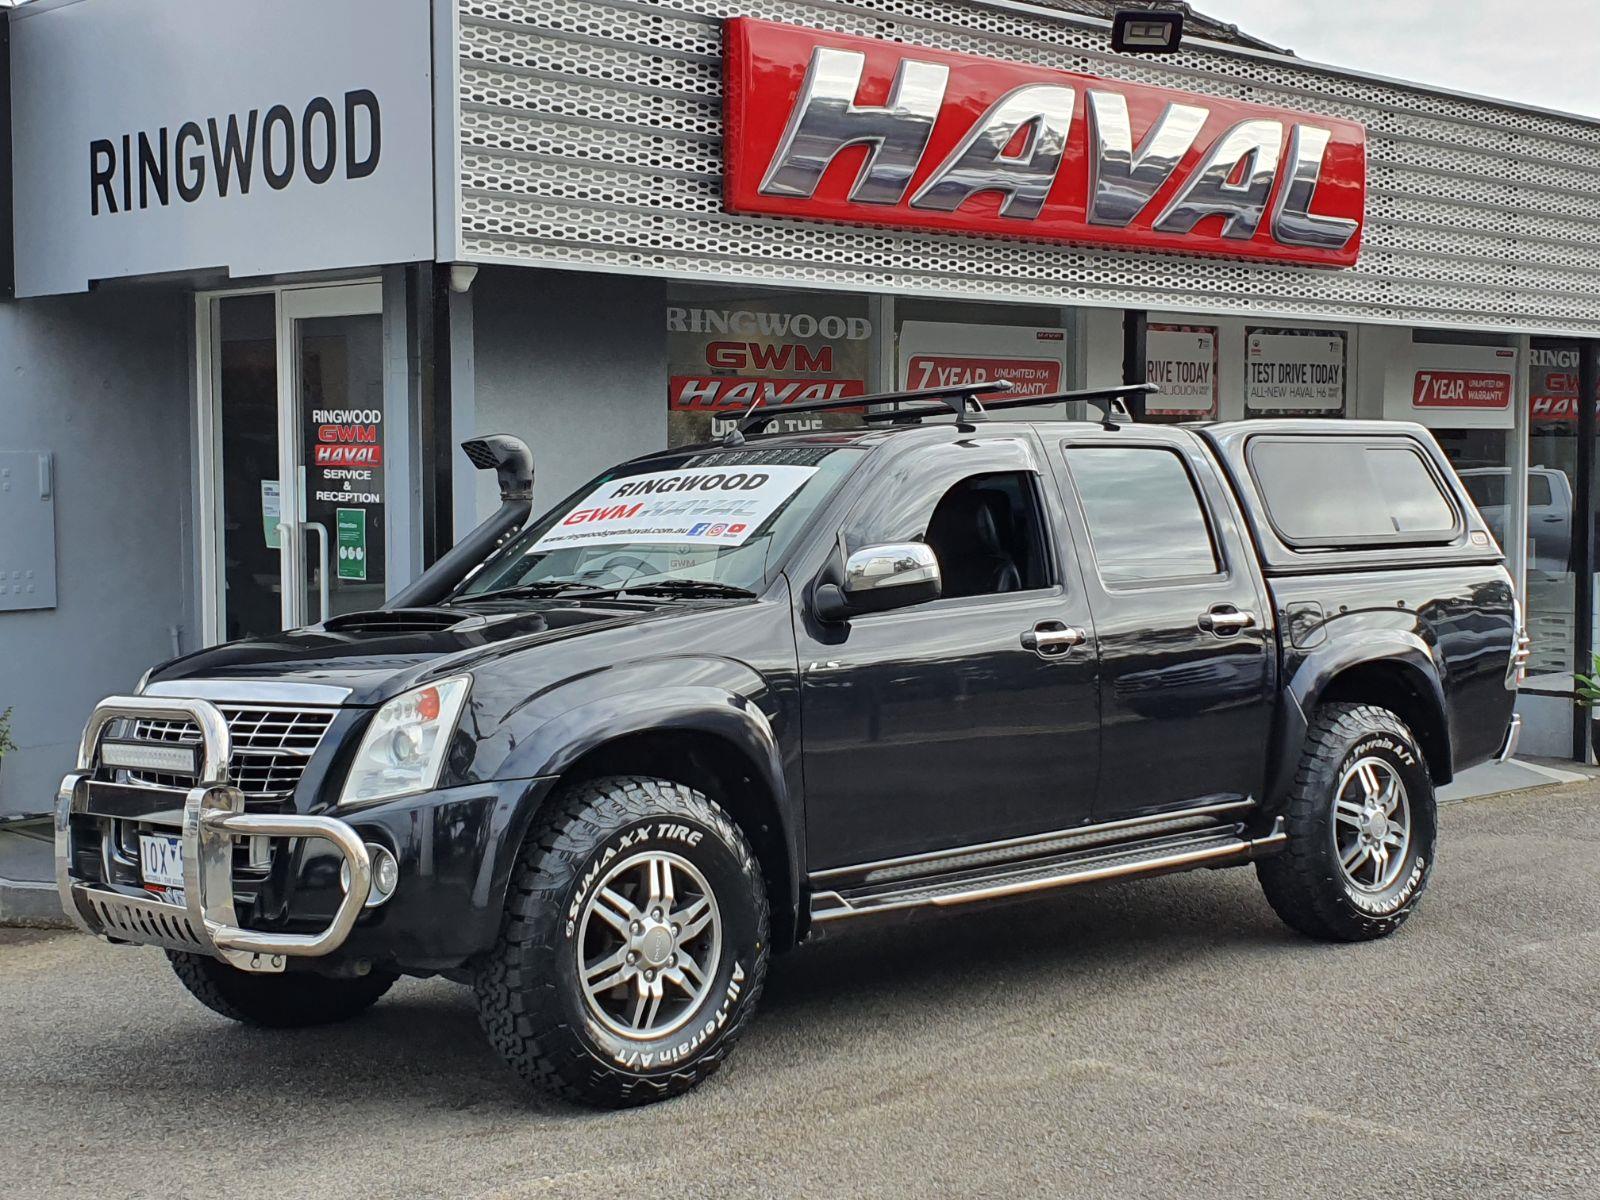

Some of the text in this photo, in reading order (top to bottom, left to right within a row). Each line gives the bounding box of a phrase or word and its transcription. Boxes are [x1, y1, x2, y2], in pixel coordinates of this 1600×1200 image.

[90, 89, 381, 216] RINGWOOD
[758, 46, 1358, 249] HAVAL
[666, 307, 873, 340] RINGWOOD
[705, 341, 832, 373] GWM
[918, 361, 935, 392] 7
[994, 368, 1049, 379] UNLIMITED KM
[1176, 361, 1210, 383] TODAY
[1251, 362, 1340, 385] TEST DRIVE TODAY
[1251, 386, 1286, 398] ALL-NEW
[1289, 387, 1315, 398] HAVAL
[1316, 387, 1327, 398] H6
[1418, 374, 1464, 402] 7 YEAR
[1467, 390, 1503, 400] WARRANTY
[312, 410, 381, 424] RINGWOOD
[318, 425, 377, 442] GWM
[317, 446, 379, 463] HAVAL
[323, 469, 372, 480] SERVICE
[343, 481, 351, 490] &
[609, 473, 769, 499] RINGWOOD
[316, 491, 380, 503] RECEPTION
[562, 499, 758, 526] GWM HAVAL
[656, 823, 704, 849] TIRE
[615, 960, 746, 1069] All-Terrain A/T
